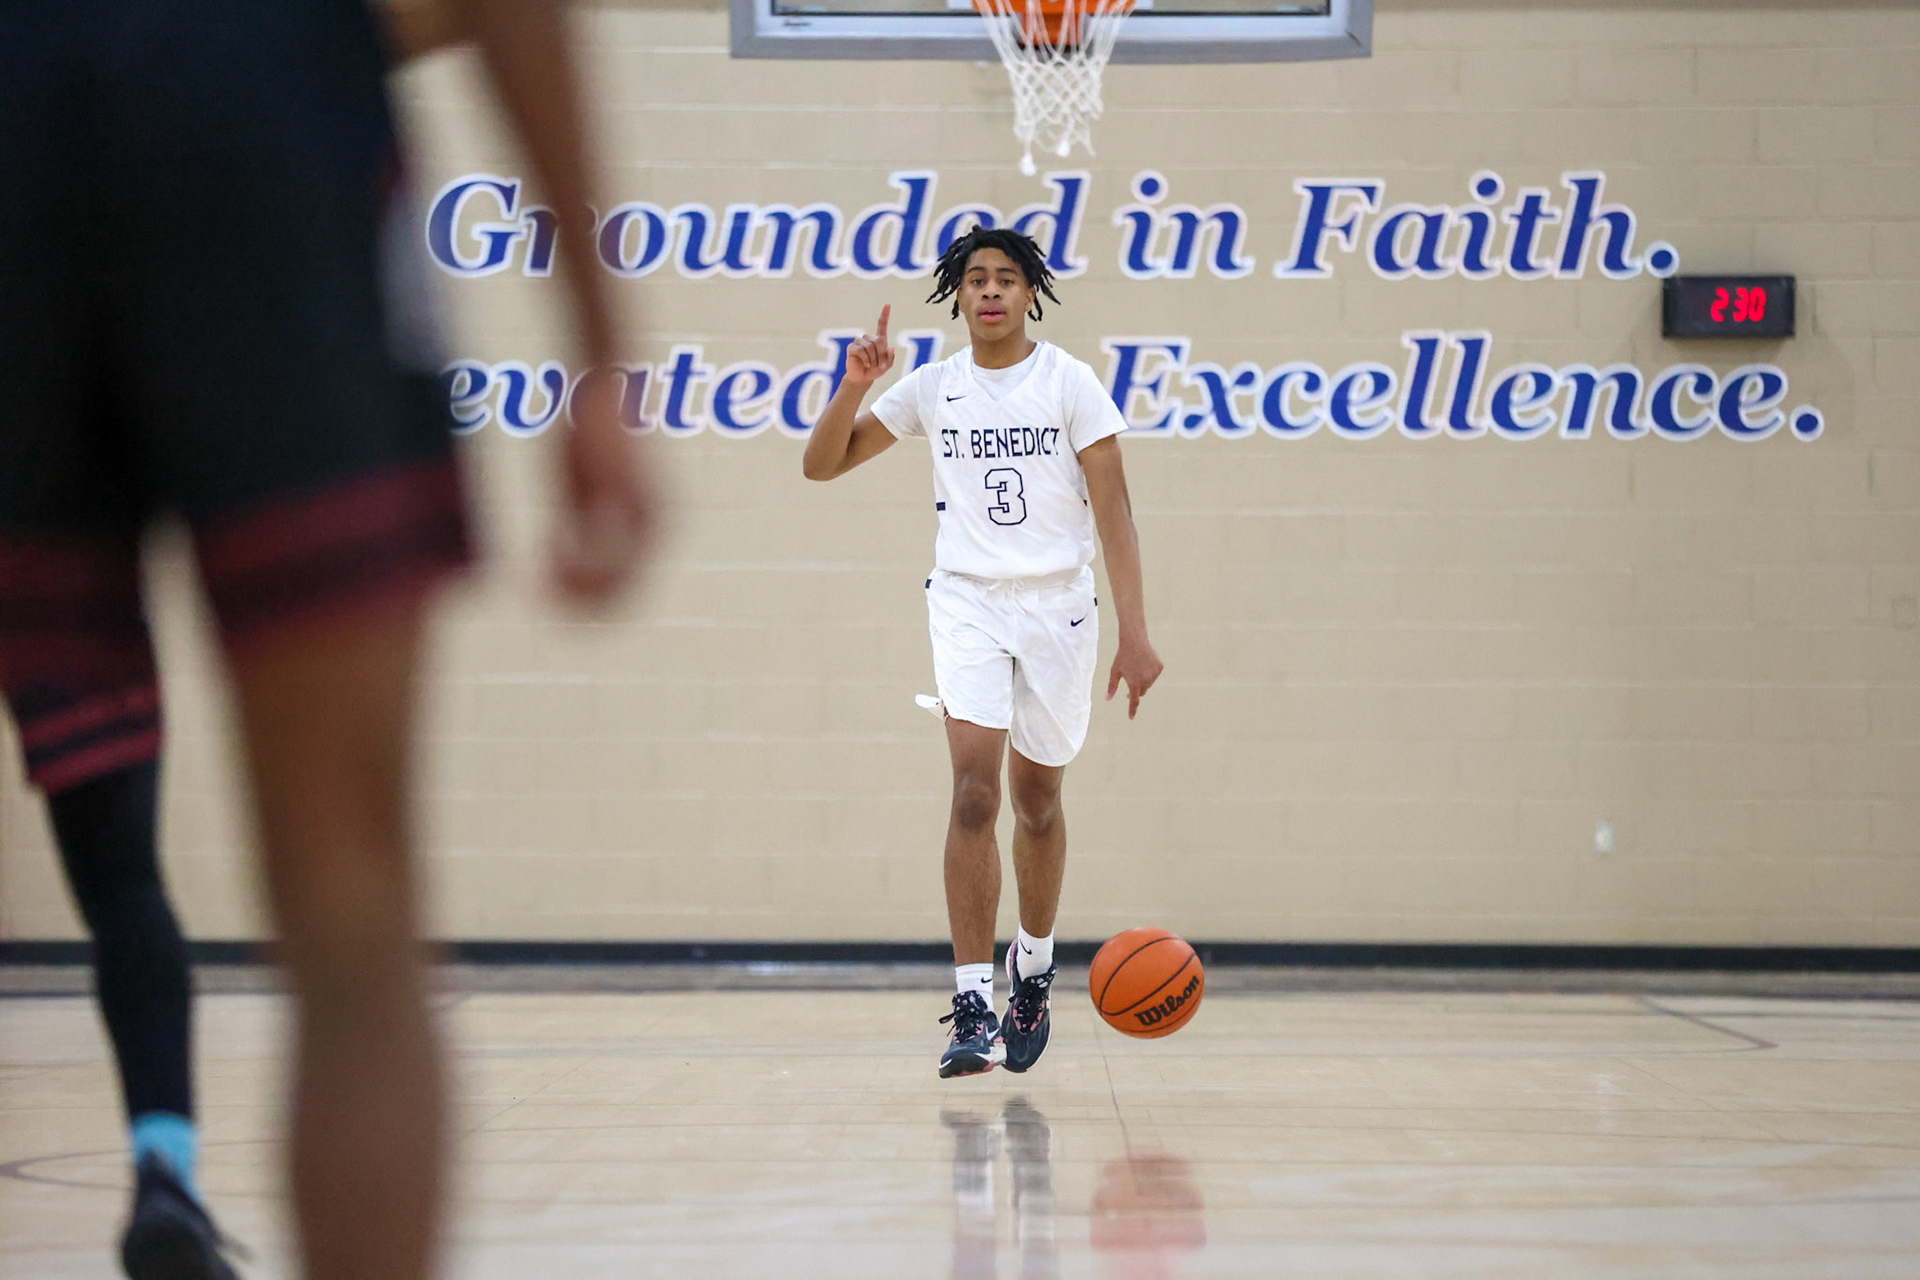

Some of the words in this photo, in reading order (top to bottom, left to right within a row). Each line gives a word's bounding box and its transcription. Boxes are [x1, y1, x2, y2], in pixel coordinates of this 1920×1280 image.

[1114, 170, 1257, 280] in
[1274, 170, 1681, 280] Faith.
[1101, 331, 1825, 442] Excellence.
[941, 428, 966, 459] ST.
[971, 427, 1060, 459] BENEDICT
[984, 467, 1028, 526] 3
[1134, 975, 1200, 1026] Wilson
